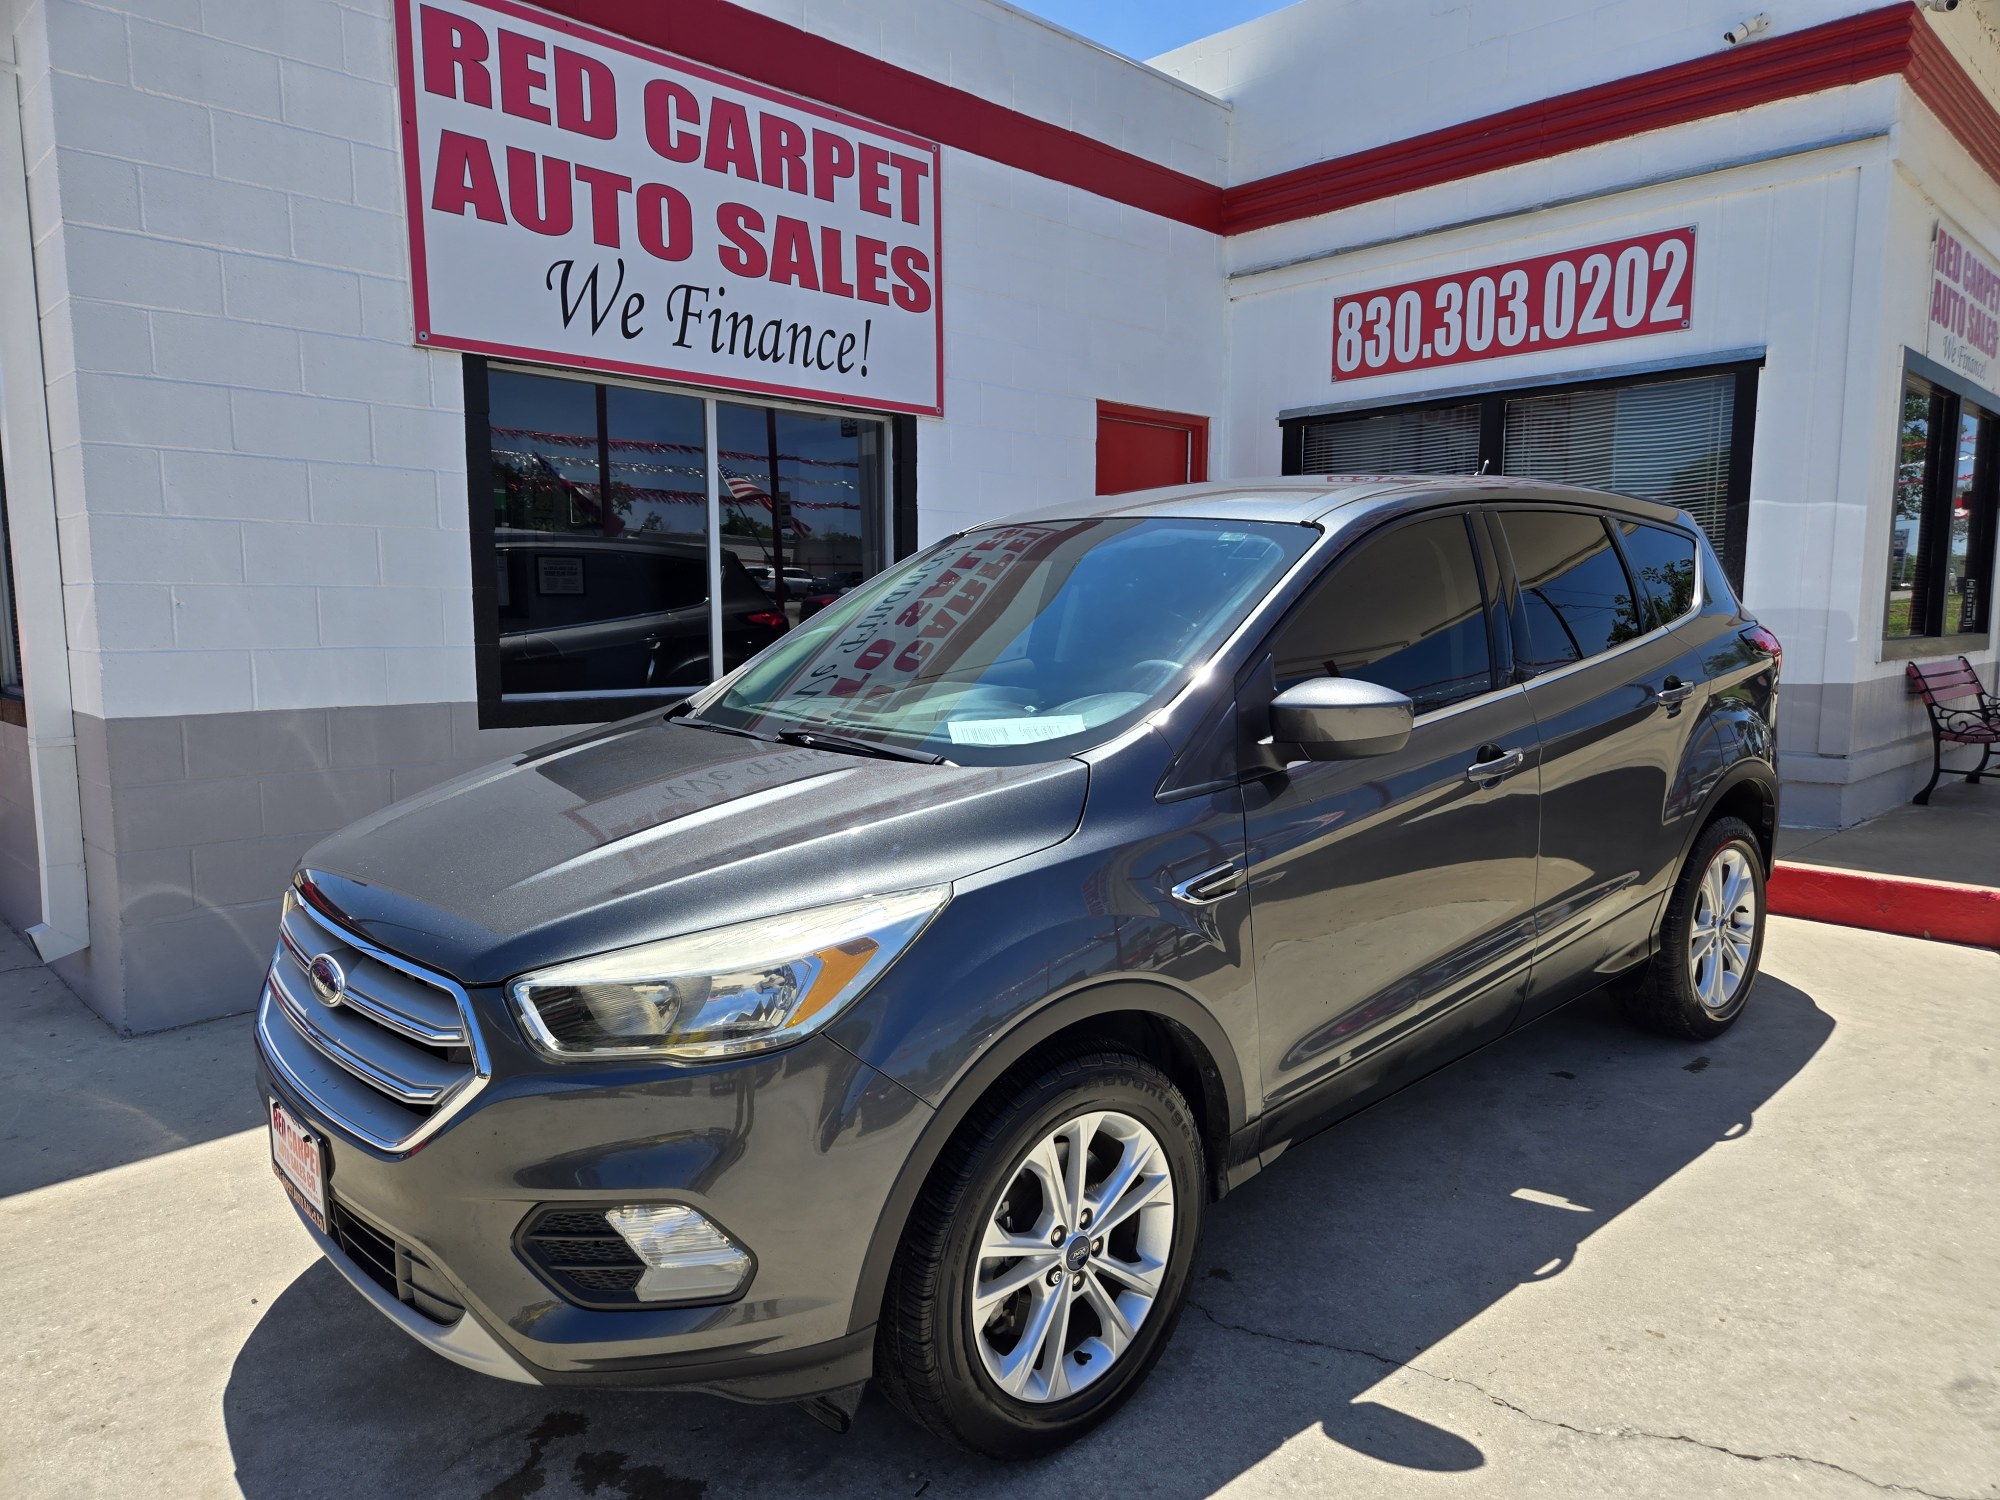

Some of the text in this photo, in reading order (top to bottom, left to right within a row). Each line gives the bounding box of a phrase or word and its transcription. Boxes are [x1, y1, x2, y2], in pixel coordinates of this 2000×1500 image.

[420, 4, 929, 226] RED CARPET
[431, 128, 932, 313] AUTO SALES
[1935, 228, 2000, 316] RED CARPET
[546, 258, 872, 377] We Finance!
[1336, 238, 1688, 373] 830.303.0202
[1931, 278, 1999, 360] AUTO SALES
[273, 1106, 287, 1141] RED
[287, 1125, 320, 1178] CARPET
